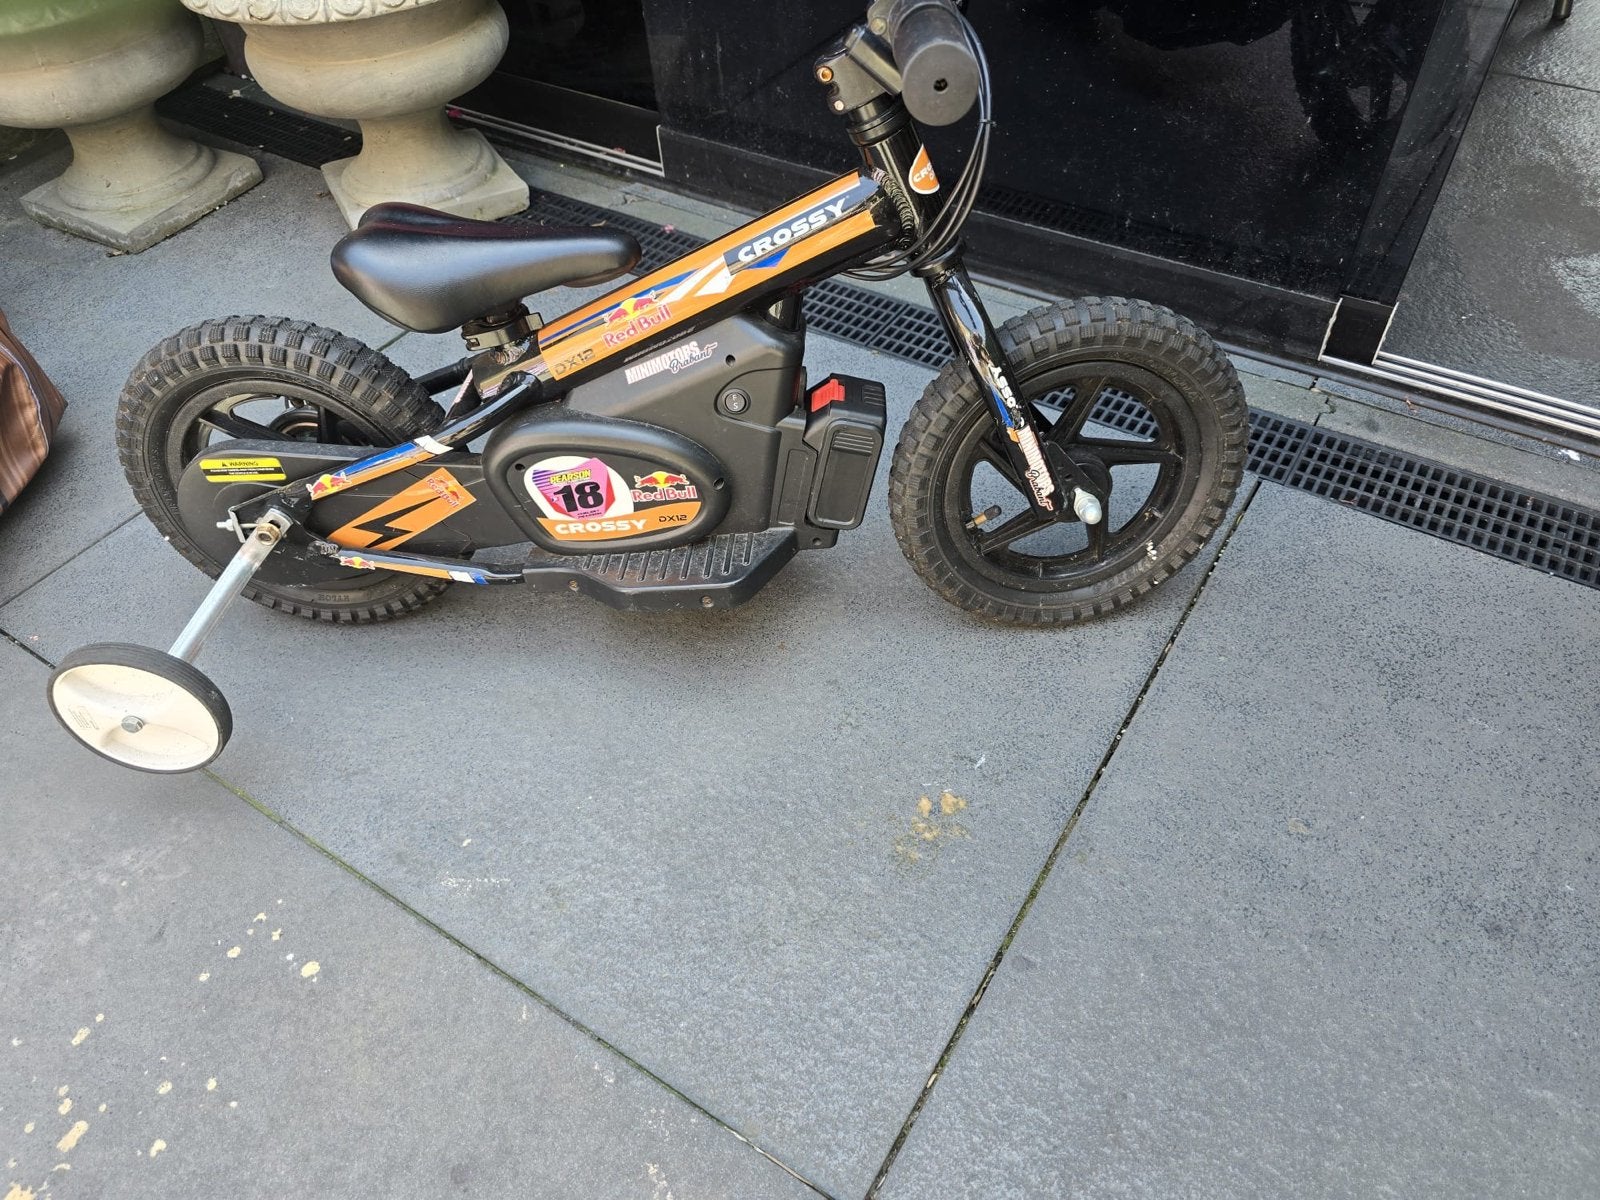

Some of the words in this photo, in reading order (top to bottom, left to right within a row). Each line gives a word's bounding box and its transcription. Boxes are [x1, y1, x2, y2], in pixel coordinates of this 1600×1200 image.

[738, 198, 845, 262] CROSSY
[602, 320, 638, 348] Red
[638, 304, 673, 332] Bull
[554, 348, 596, 376] DX12
[625, 341, 700, 385] MINIMOTORS
[670, 342, 717, 374] Brabant
[550, 469, 592, 485] PEARSON
[427, 478, 446, 495] Red
[441, 493, 460, 508] Bull
[553, 481, 604, 513] 18
[632, 487, 665, 502] Red
[665, 485, 698, 501] Bull
[554, 519, 648, 535] CROSSY
[658, 514, 688, 523] DX12
